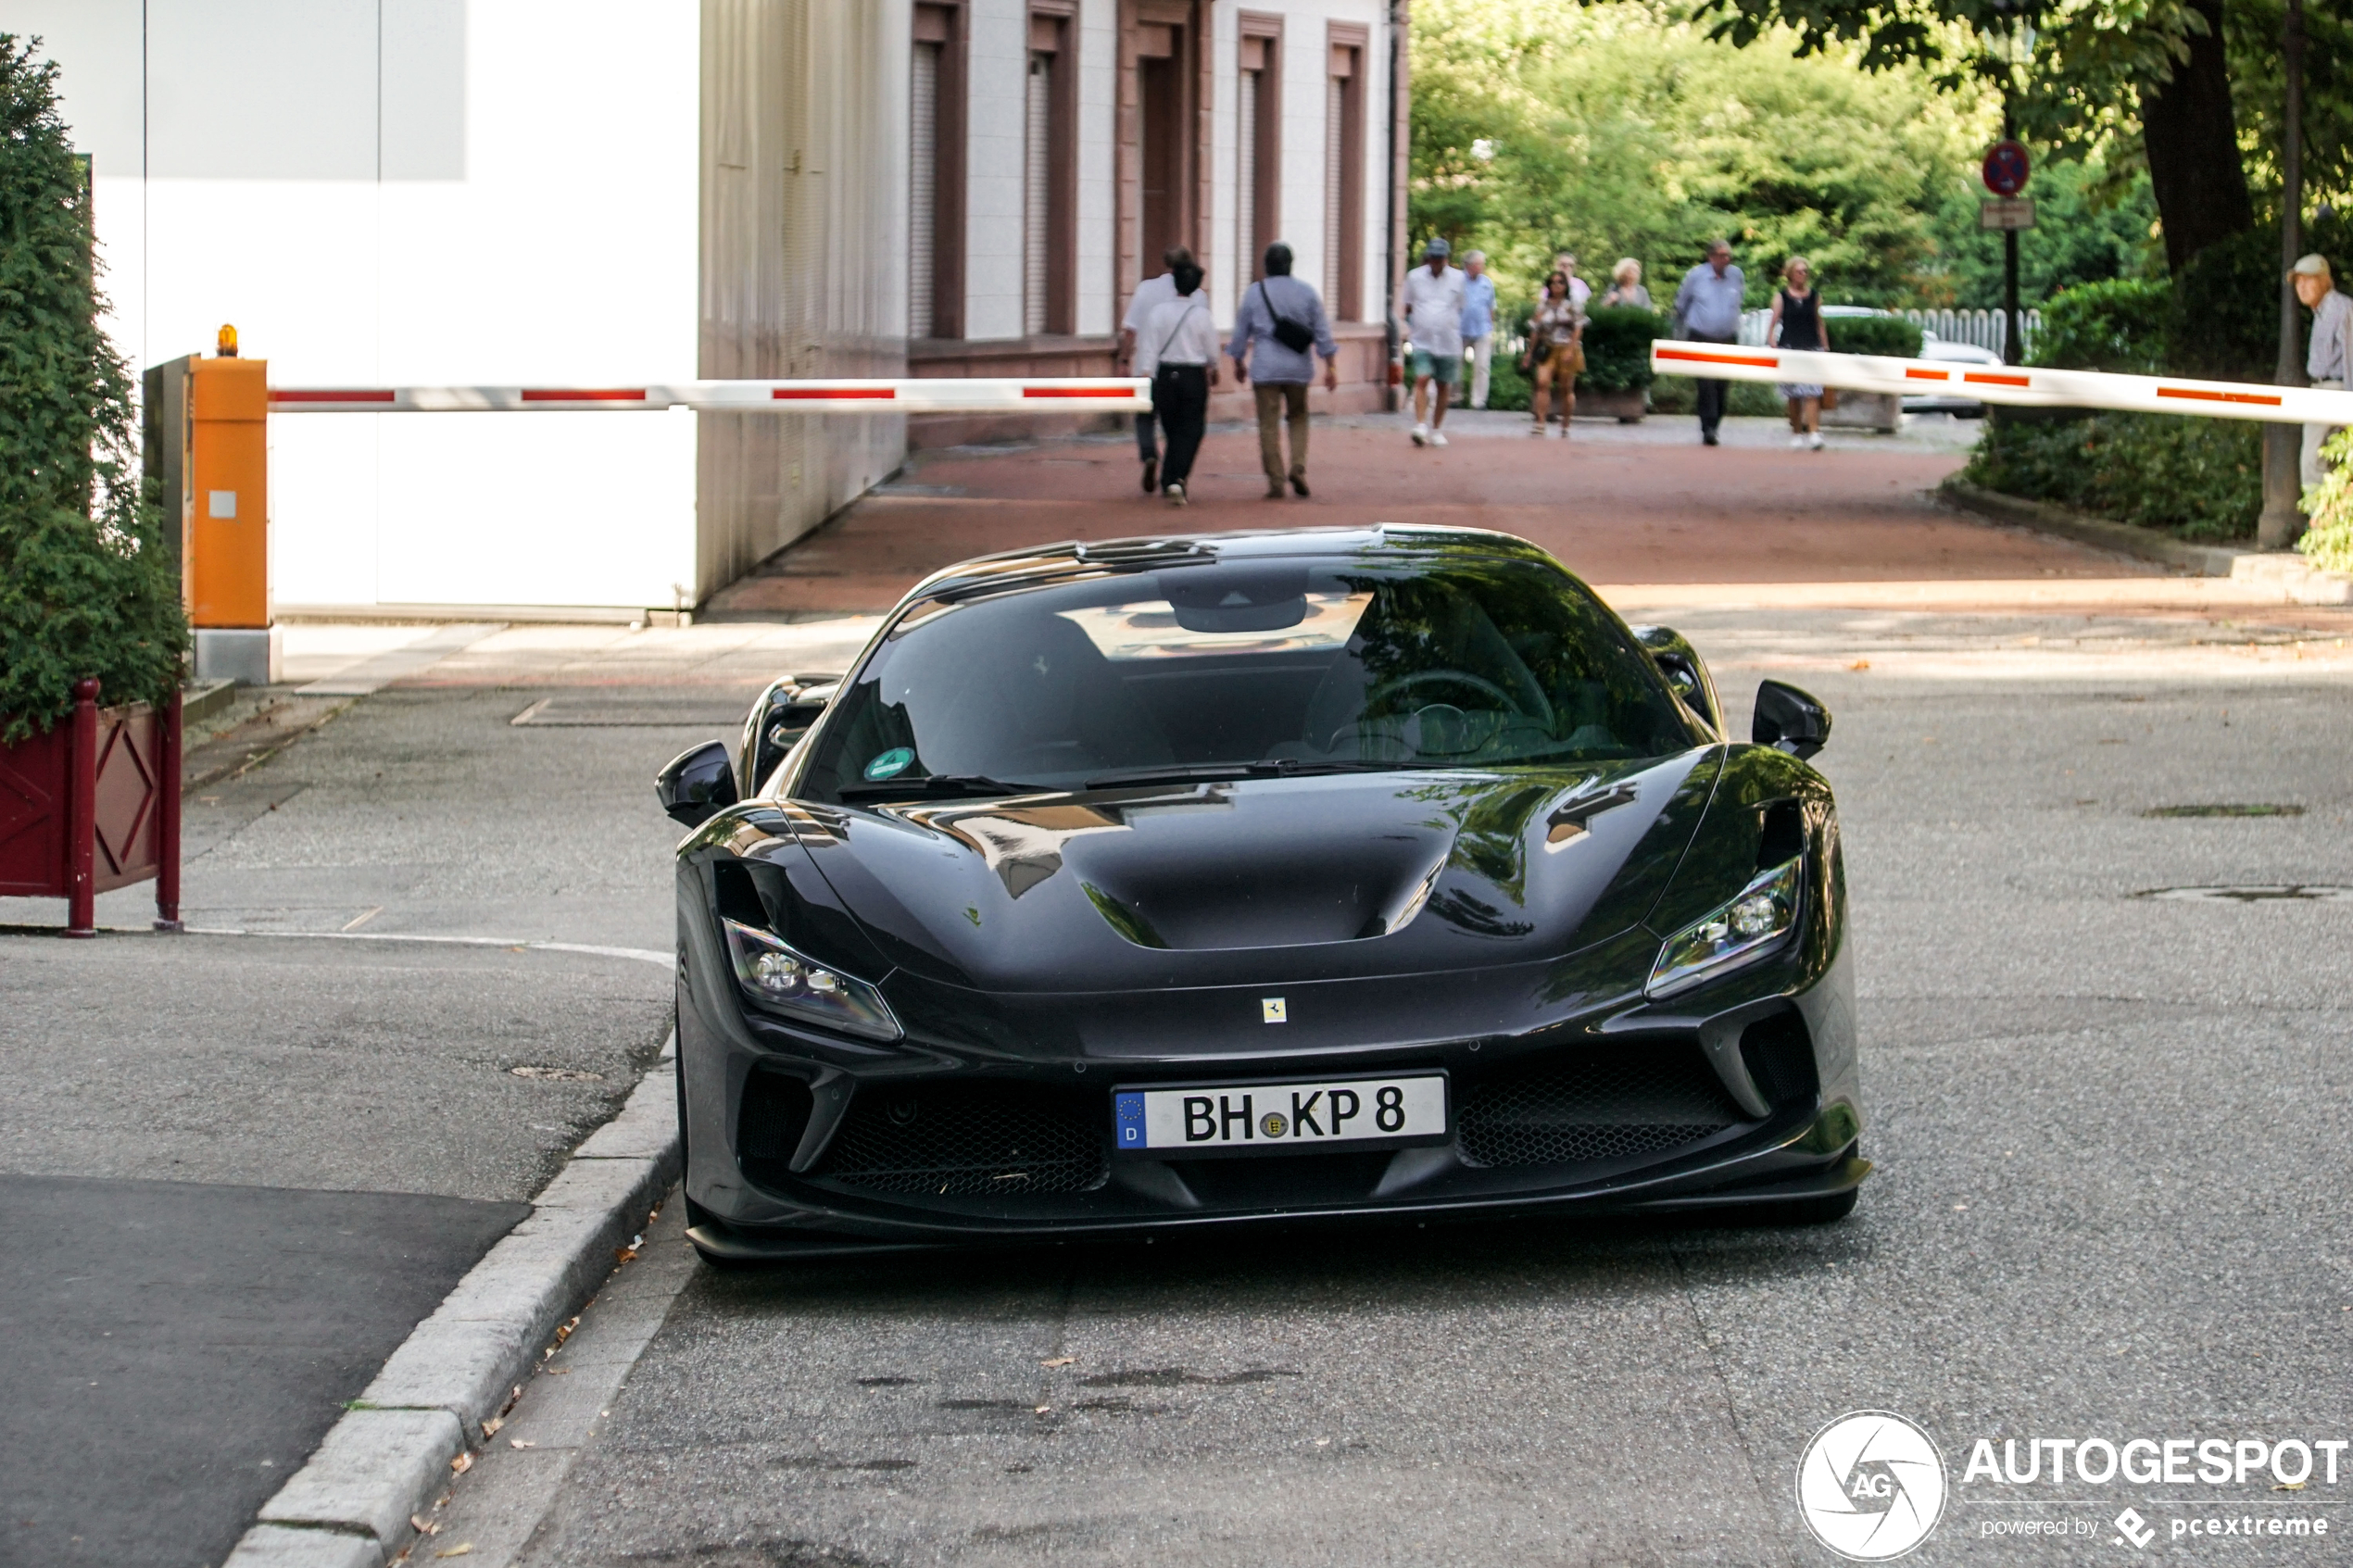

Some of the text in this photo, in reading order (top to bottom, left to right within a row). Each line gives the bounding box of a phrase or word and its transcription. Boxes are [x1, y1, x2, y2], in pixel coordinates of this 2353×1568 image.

[1184, 1085, 1405, 1142] BH KP 8
[1126, 1128, 1137, 1141] D
